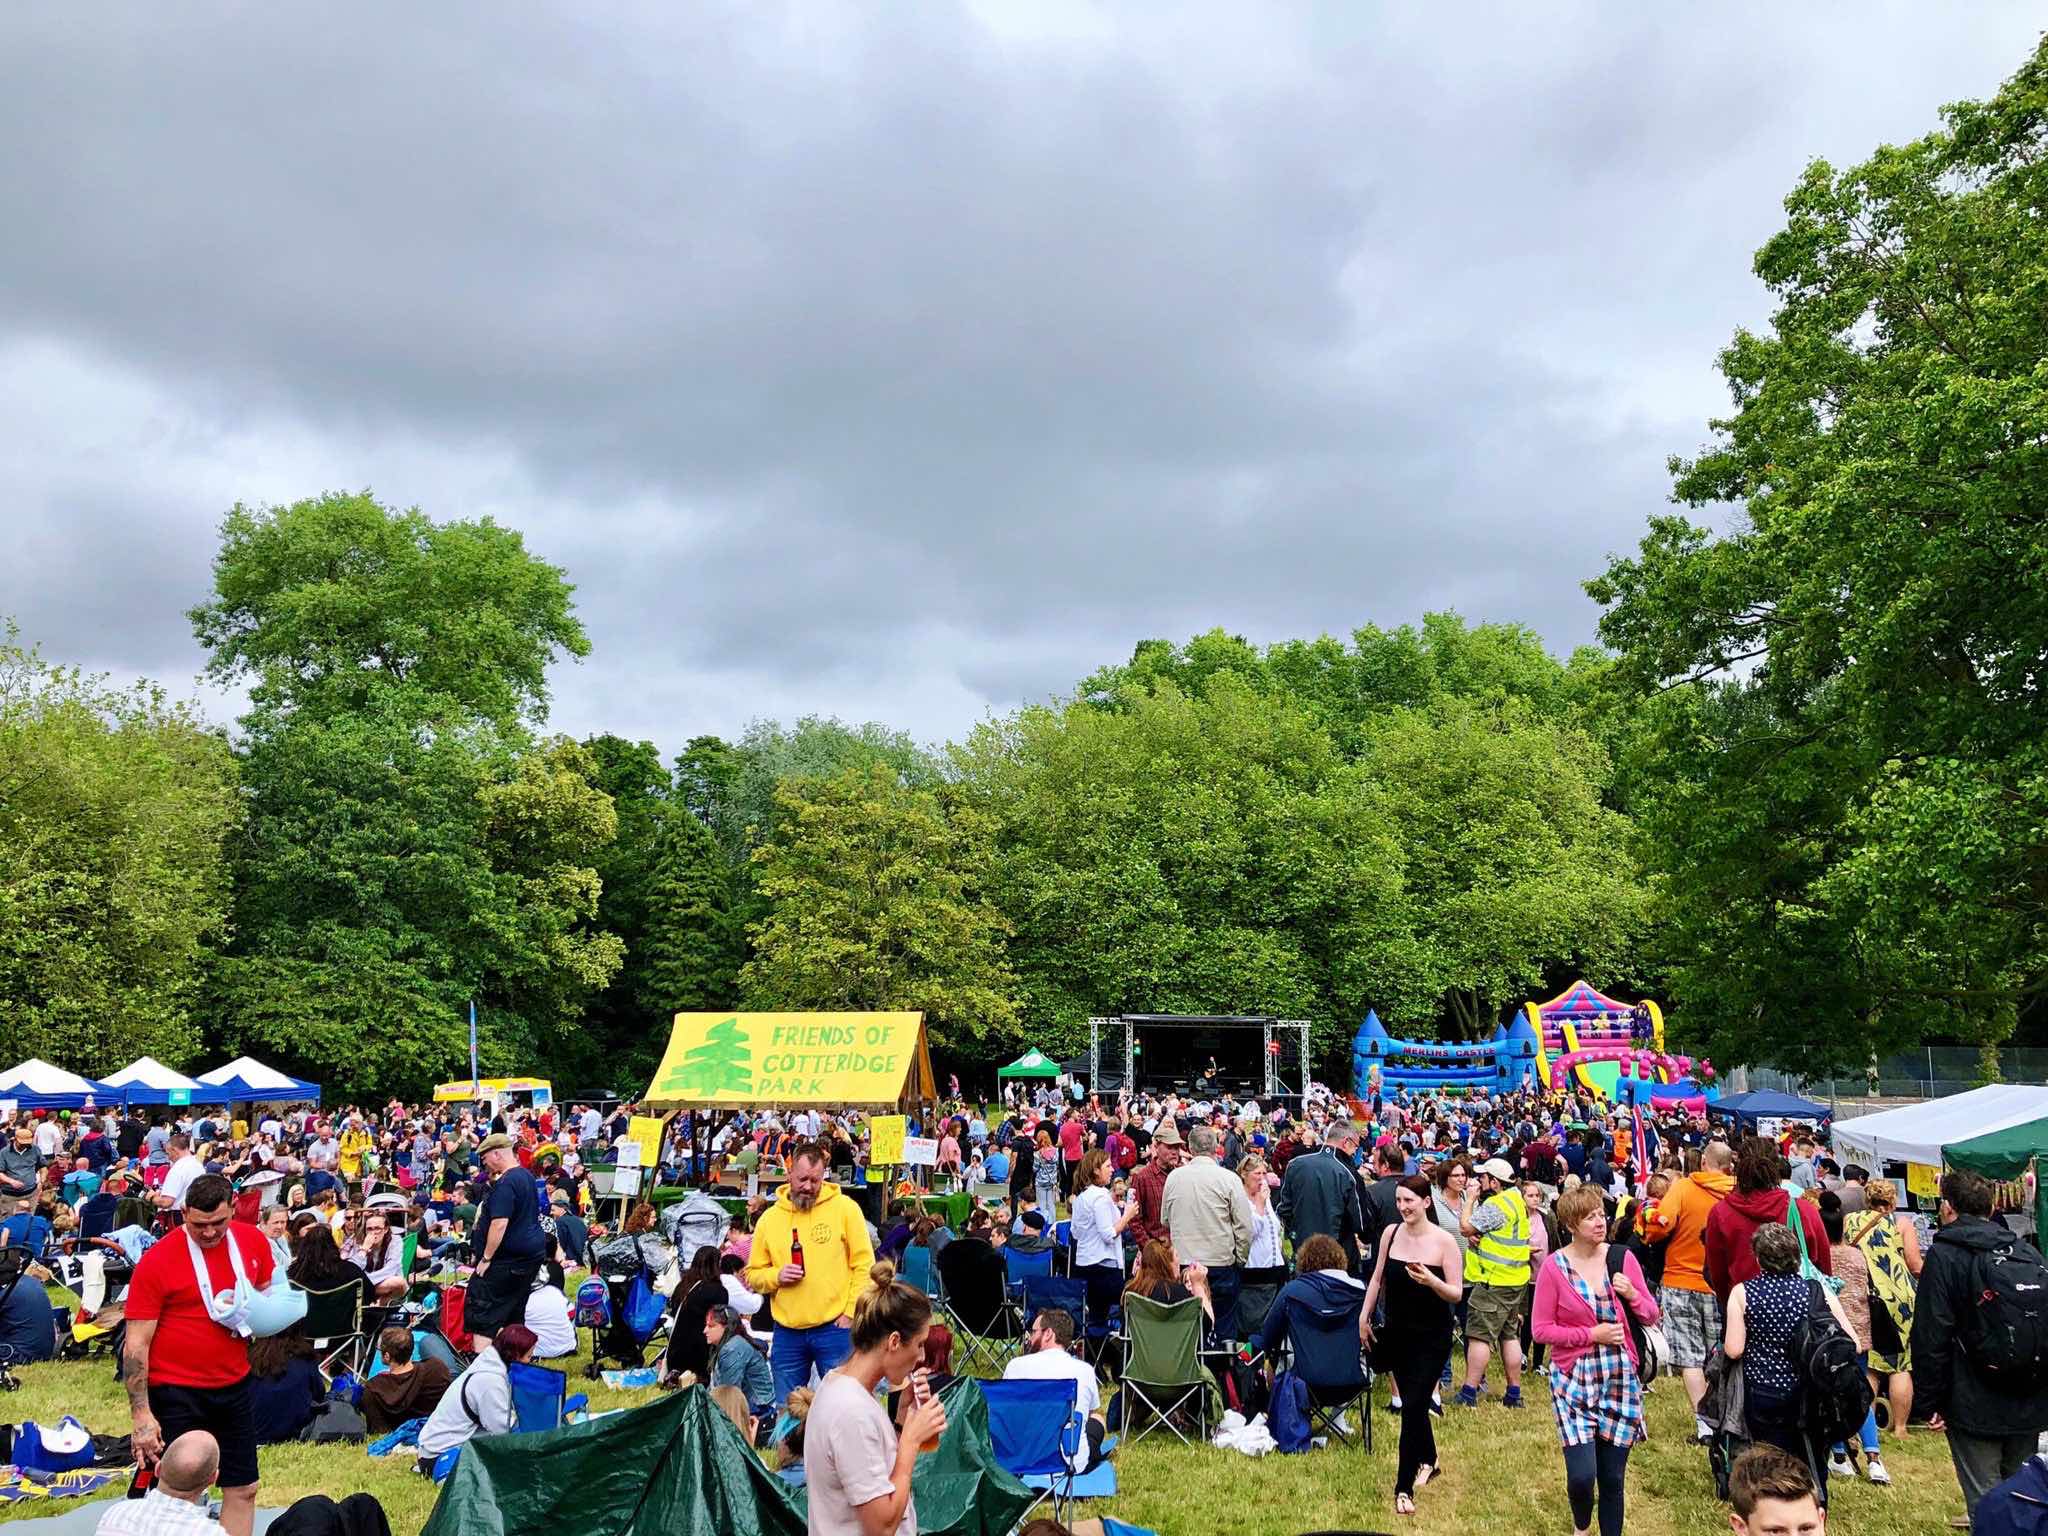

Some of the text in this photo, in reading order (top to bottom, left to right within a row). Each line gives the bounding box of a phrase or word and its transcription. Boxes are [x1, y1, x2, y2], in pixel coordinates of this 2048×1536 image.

[771, 1025, 895, 1046] FRIENDS OF
[1403, 1046, 1495, 1057] MERLINS CASTLE
[763, 1054, 897, 1073] COTTERIDGE
[757, 1077, 824, 1096] PARK
